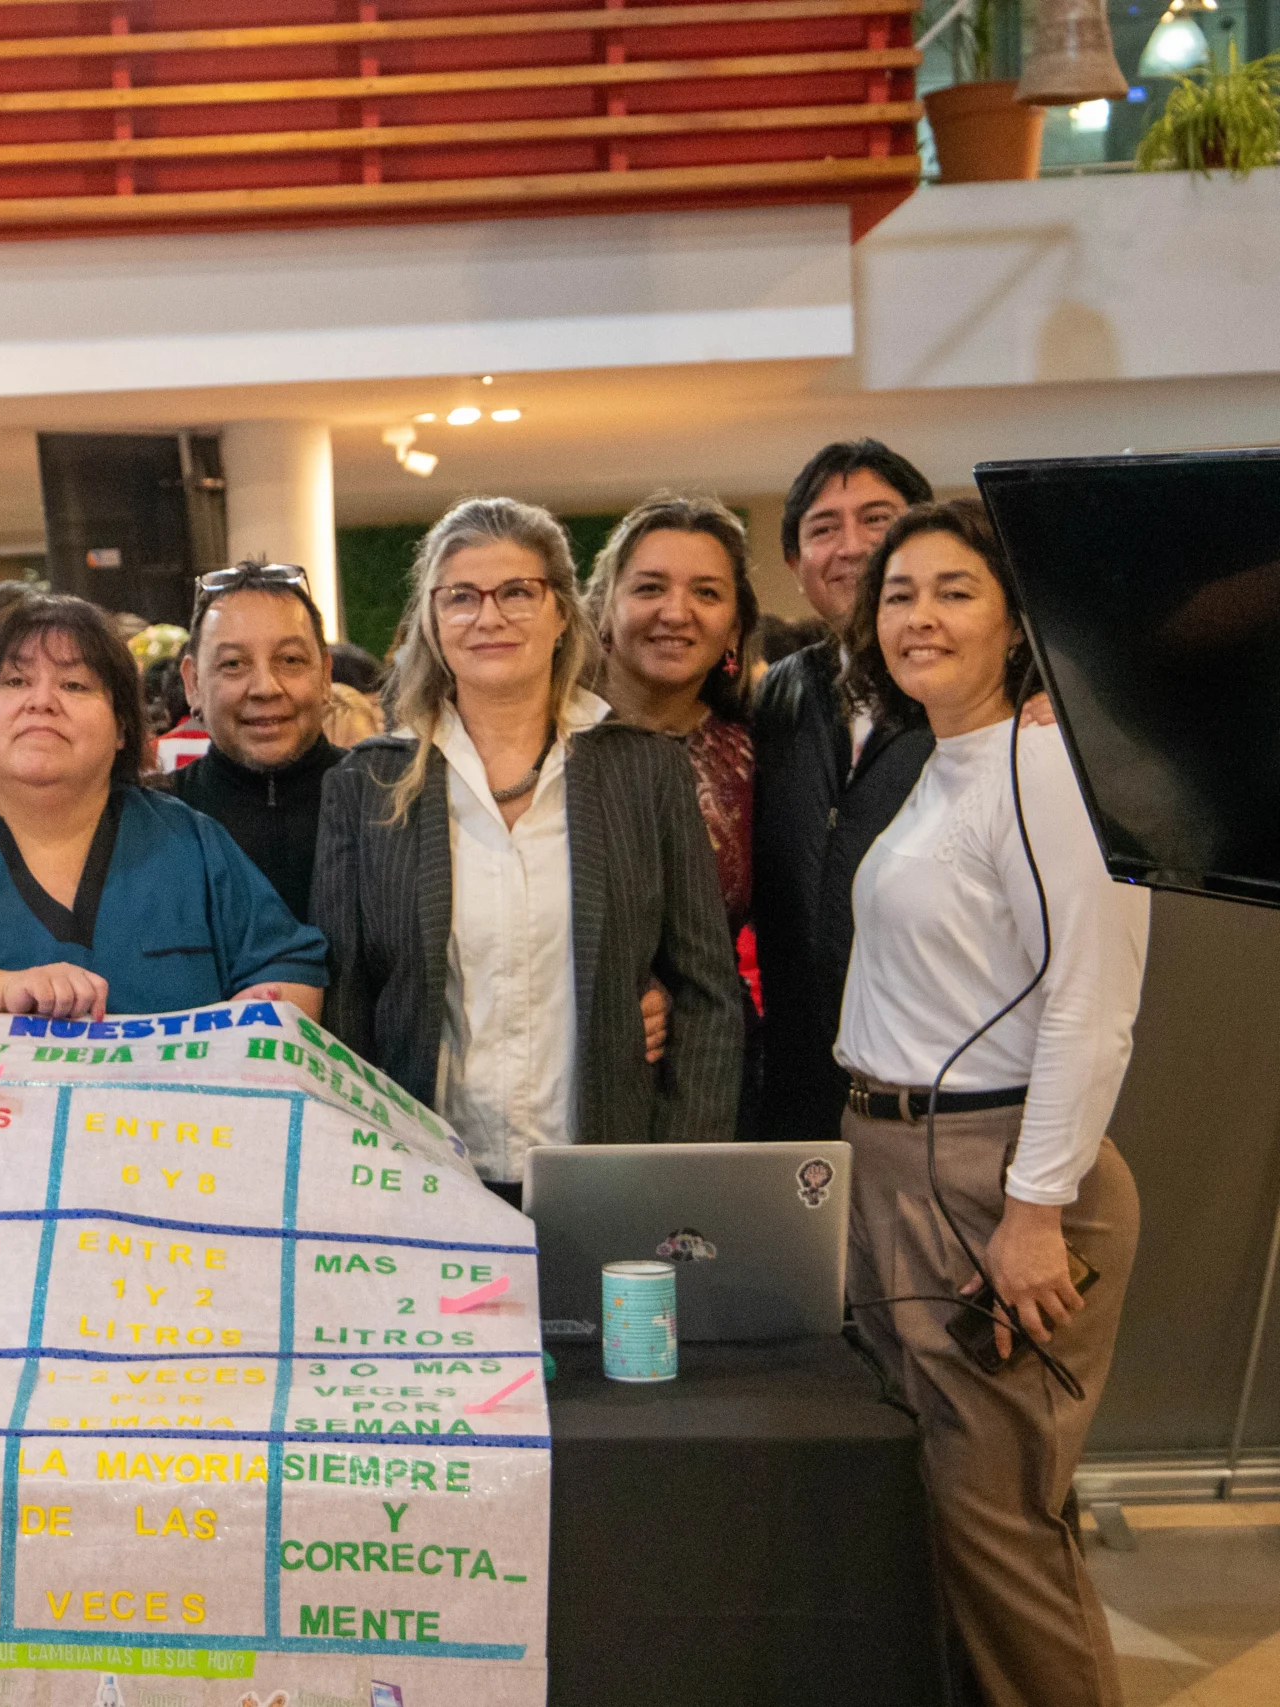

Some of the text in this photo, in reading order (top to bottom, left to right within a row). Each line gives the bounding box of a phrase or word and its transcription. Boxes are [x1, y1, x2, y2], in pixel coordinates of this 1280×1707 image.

[9, 1002, 283, 1040] NUESTRA
[158, 1040, 209, 1062] TU
[244, 1035, 392, 1129] HUELLA
[84, 1112, 233, 1149] ENTRE
[120, 1164, 216, 1195] 6 Y 8
[351, 1164, 438, 1193] DE 8
[77, 1230, 227, 1270] ENTRE
[314, 1253, 490, 1283] MAS DE
[111, 1277, 214, 1307] 1 Y 2
[399, 1297, 415, 1315] 2
[78, 1314, 243, 1347] LITROS
[314, 1326, 473, 1346] LITROS
[126, 1366, 267, 1385] VECES
[308, 1363, 327, 1376] 3
[413, 1361, 500, 1375] MAS
[109, 1393, 203, 1406] POR
[314, 1385, 456, 1398] VECES
[48, 1413, 235, 1430] SEMANA
[352, 1401, 435, 1413] POR
[295, 1418, 474, 1435] SEMANA
[18, 1447, 269, 1484] LA MAYORIA
[282, 1453, 470, 1493] SIEMPRE
[19, 1503, 219, 1542] DE LAS
[383, 1502, 407, 1533] Y
[45, 1589, 207, 1626] VECES
[299, 1605, 441, 1644] MENTE
[141, 1650, 198, 1669] DESDE
[207, 1651, 246, 1676] HOY?
